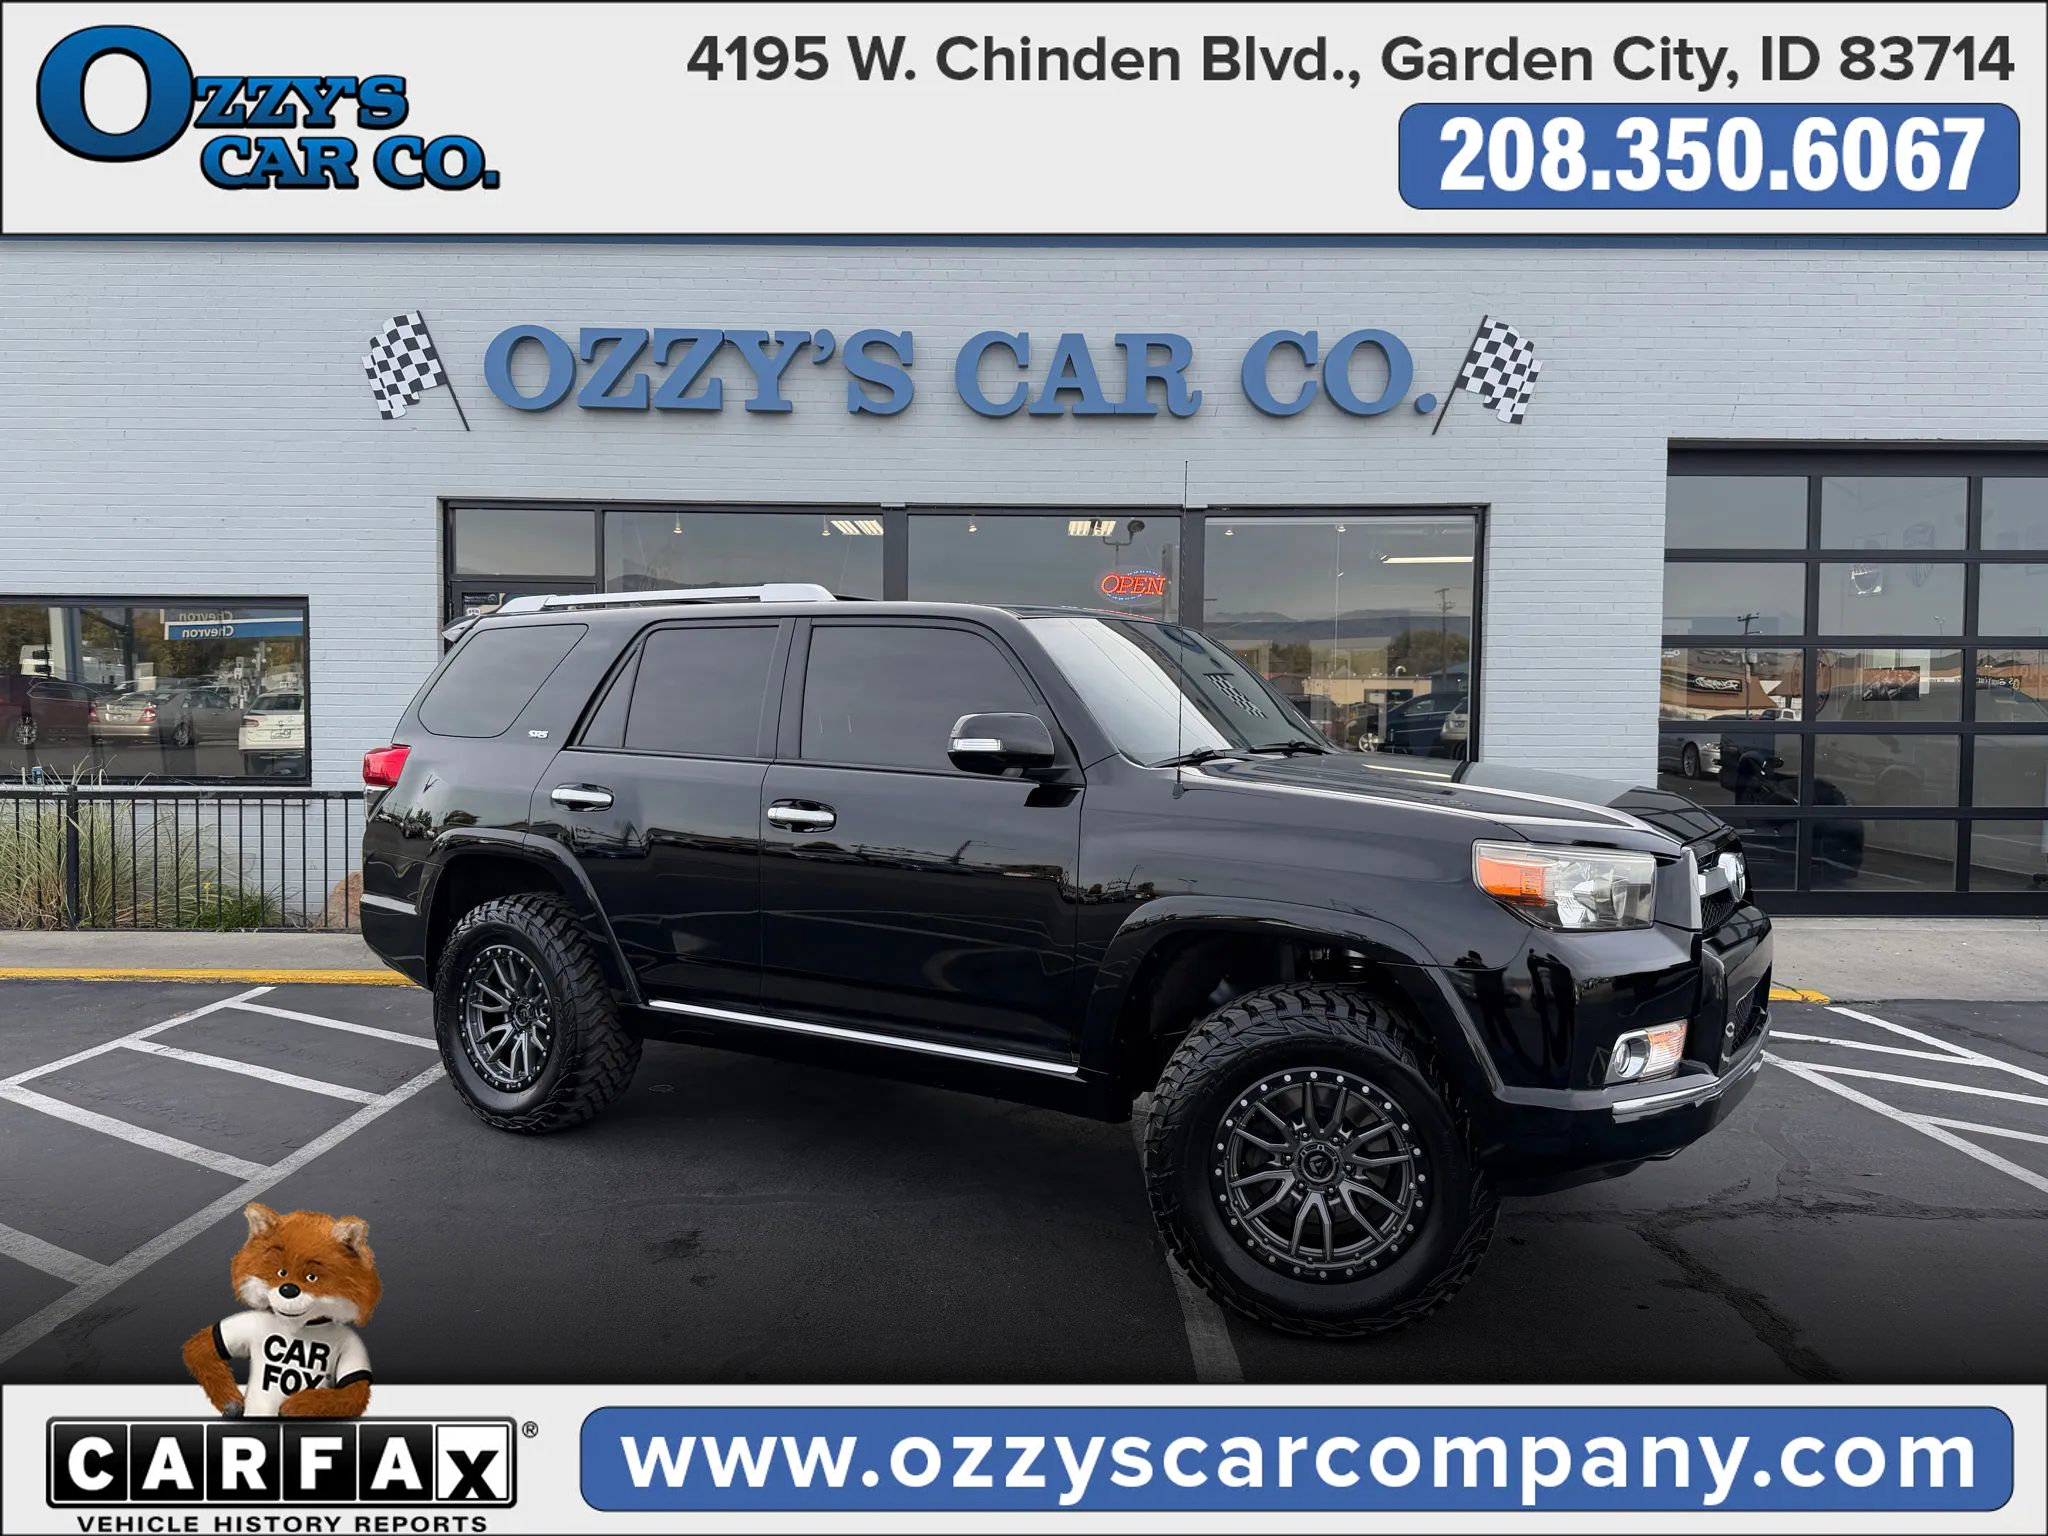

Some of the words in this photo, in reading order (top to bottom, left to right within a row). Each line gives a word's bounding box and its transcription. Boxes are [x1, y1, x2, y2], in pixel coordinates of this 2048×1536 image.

[484, 324, 915, 415] OZZY'S
[954, 330, 1203, 418] CAR
[1241, 328, 1437, 416] CO.
[1101, 575, 1166, 596] OPEN
